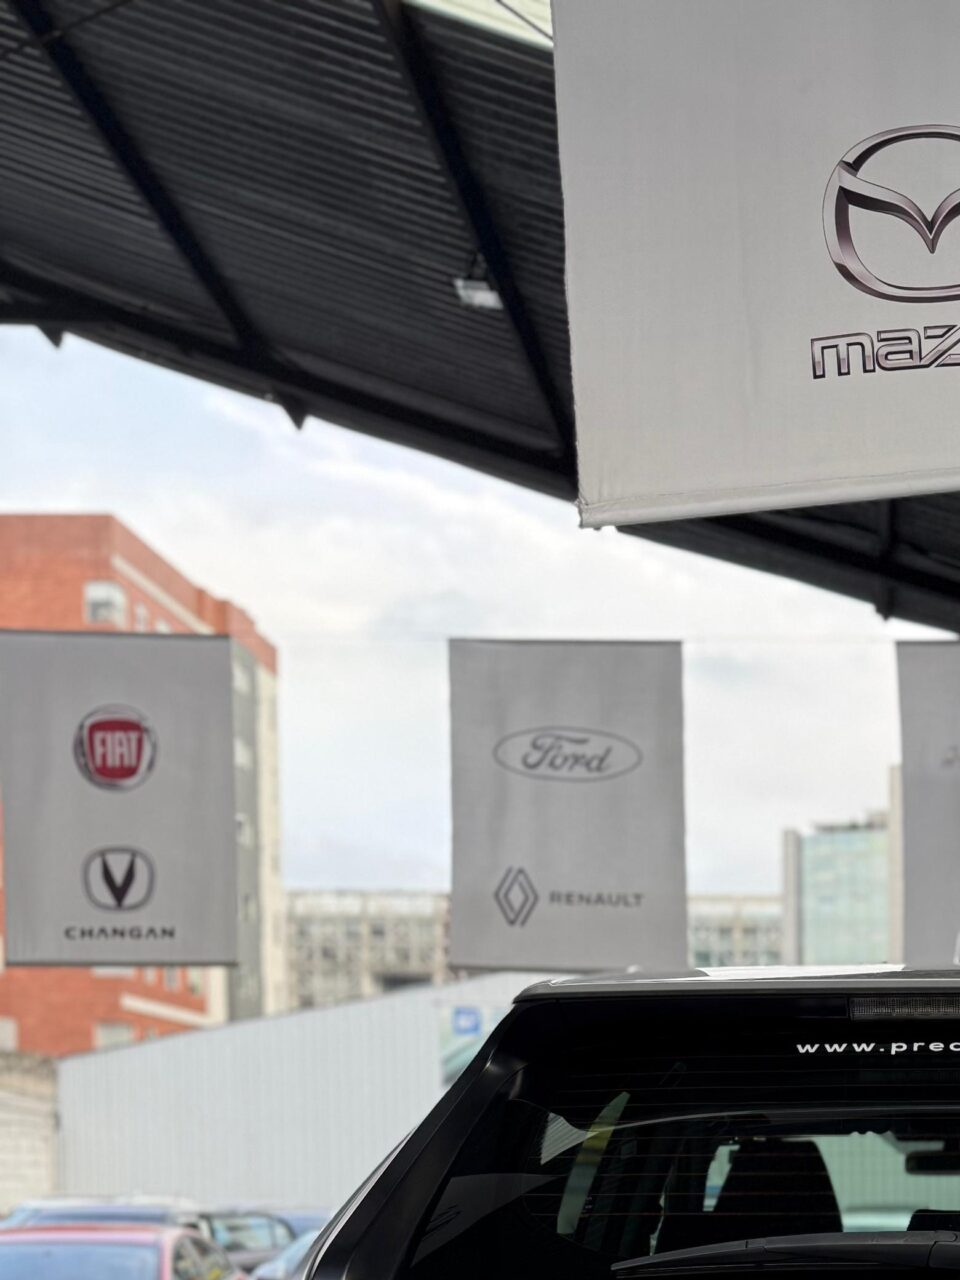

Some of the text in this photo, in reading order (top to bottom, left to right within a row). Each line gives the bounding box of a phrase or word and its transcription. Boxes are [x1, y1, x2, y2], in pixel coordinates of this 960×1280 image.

[92, 730, 142, 769] FIAT
[521, 733, 614, 773] Ford
[549, 890, 645, 907] RENAULT
[64, 926, 176, 941] CHANGAN
